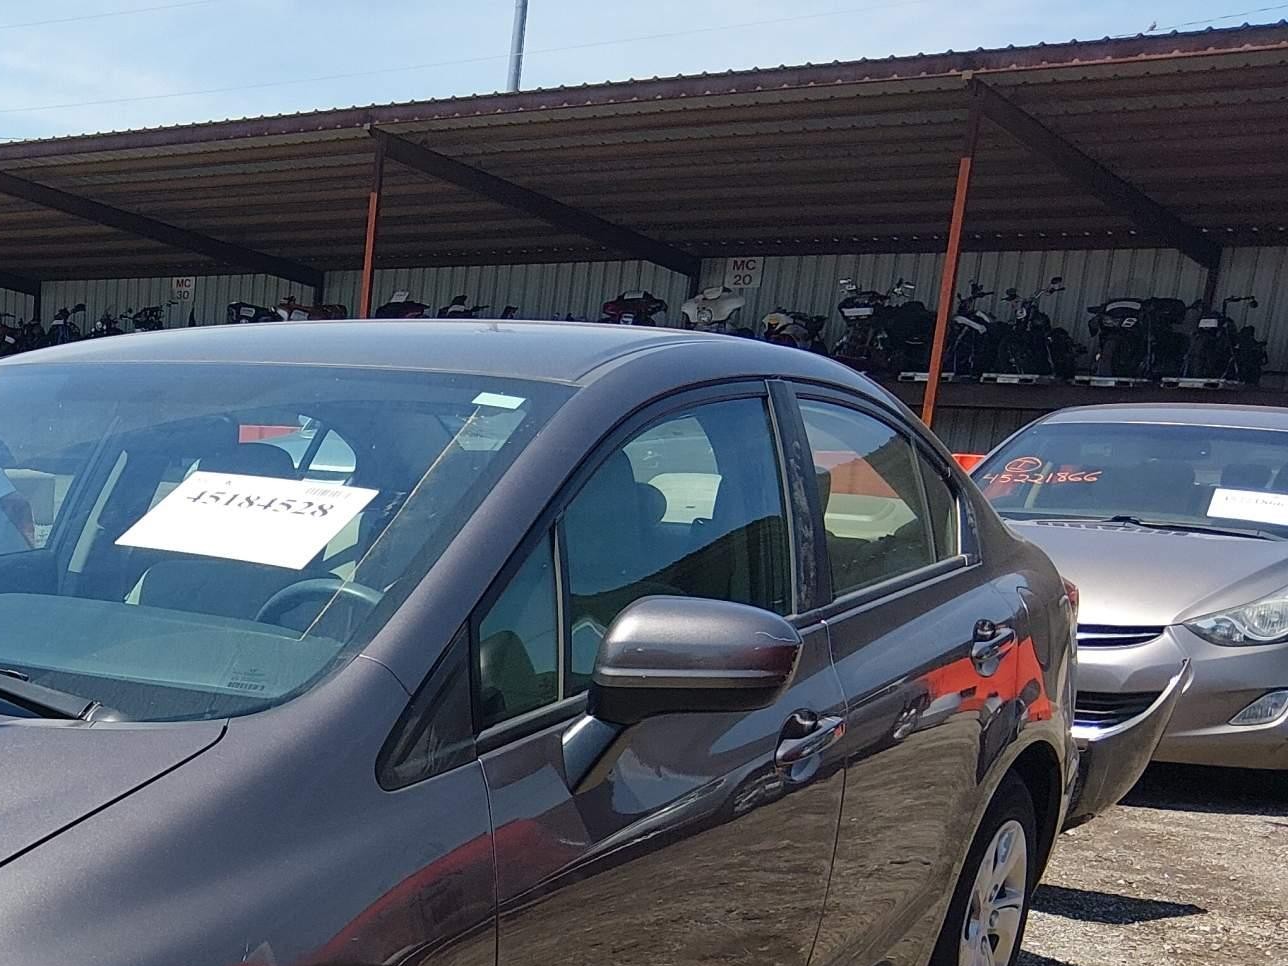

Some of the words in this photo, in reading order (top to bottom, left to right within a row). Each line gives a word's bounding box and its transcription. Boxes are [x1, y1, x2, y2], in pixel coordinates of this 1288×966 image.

[733, 259, 756, 271] MC
[176, 279, 191, 288] MC
[733, 274, 752, 286] 20
[177, 290, 189, 300] 30
[983, 471, 1103, 484] 45221866
[186, 490, 335, 517] 45184528
